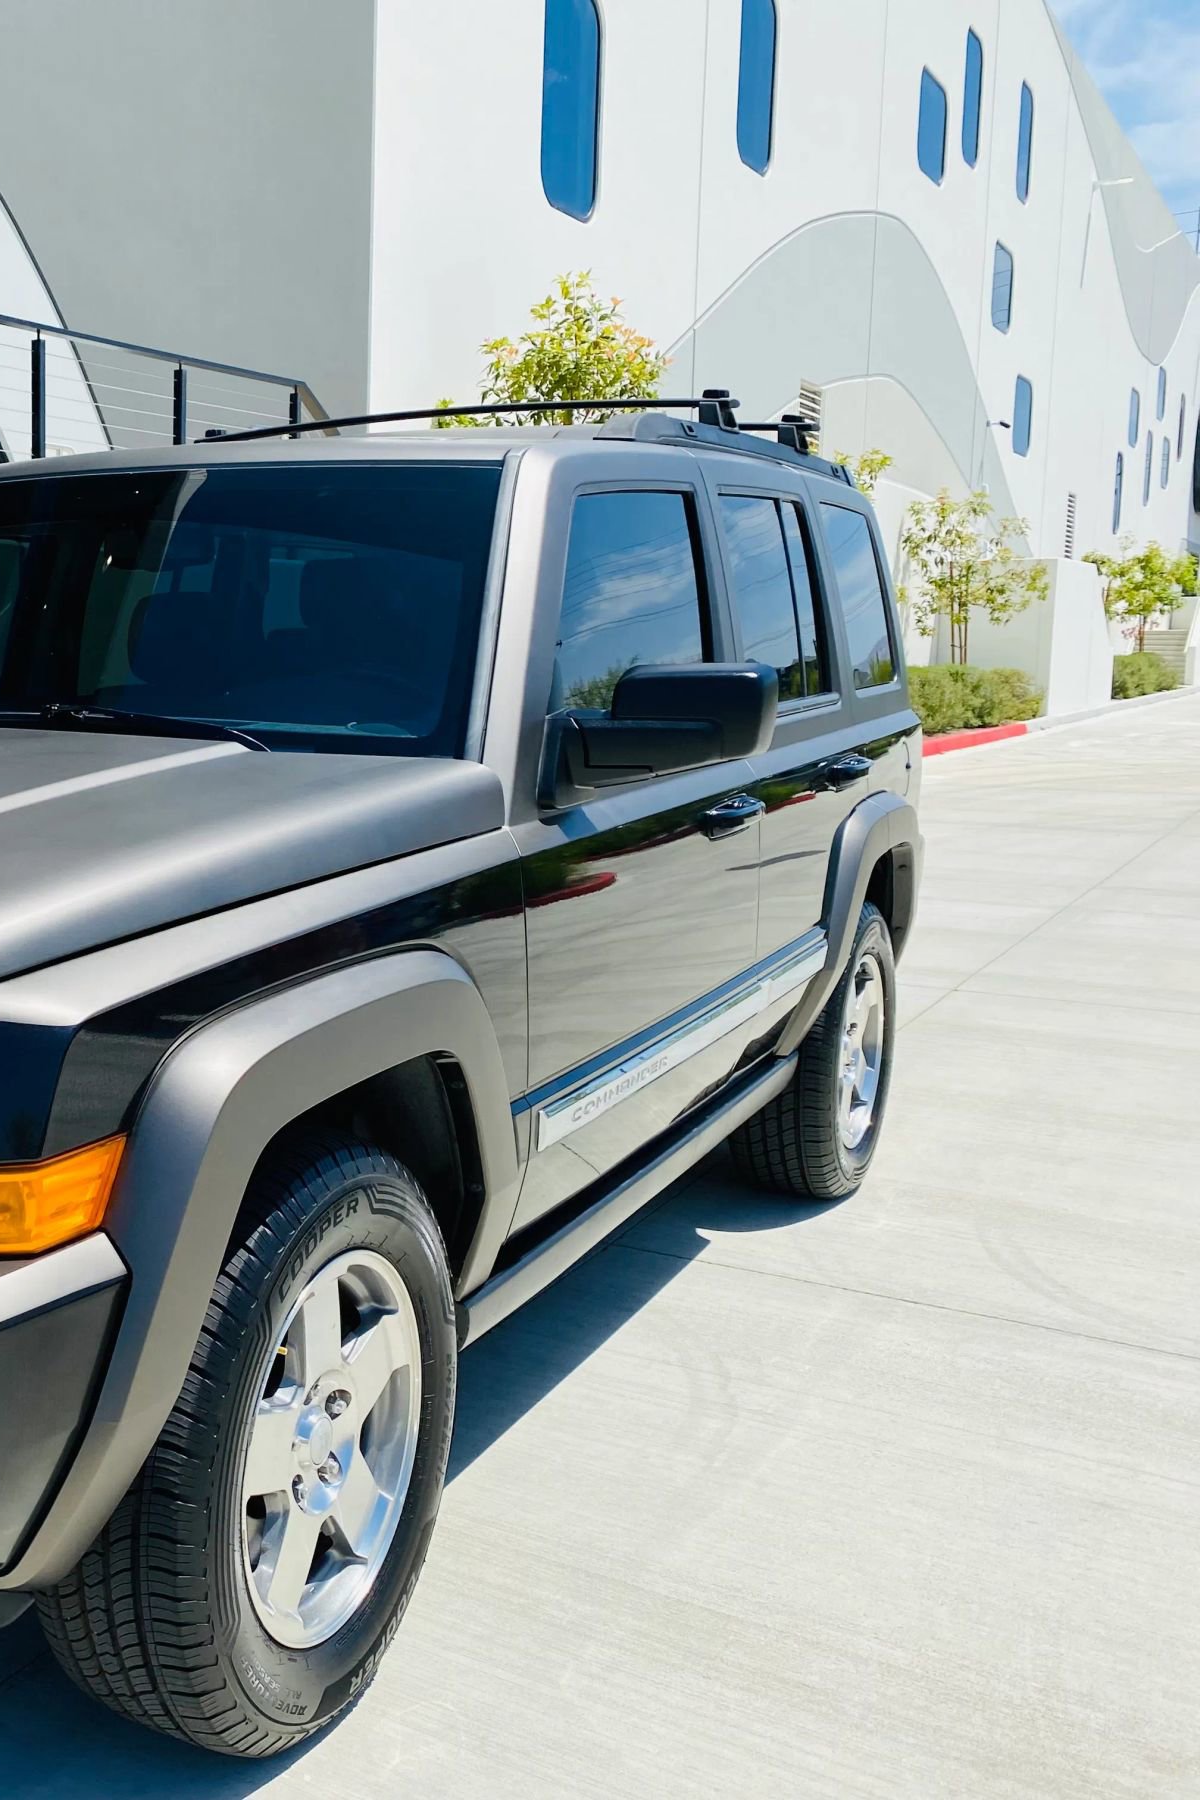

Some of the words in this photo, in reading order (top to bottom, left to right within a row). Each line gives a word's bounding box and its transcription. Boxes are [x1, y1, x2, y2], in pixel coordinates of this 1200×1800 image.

[571, 1056, 668, 1122] COMMANDER
[277, 1194, 360, 1303] COOPER
[253, 1656, 280, 1693] SEASO
[349, 1572, 416, 1695] COOPER
